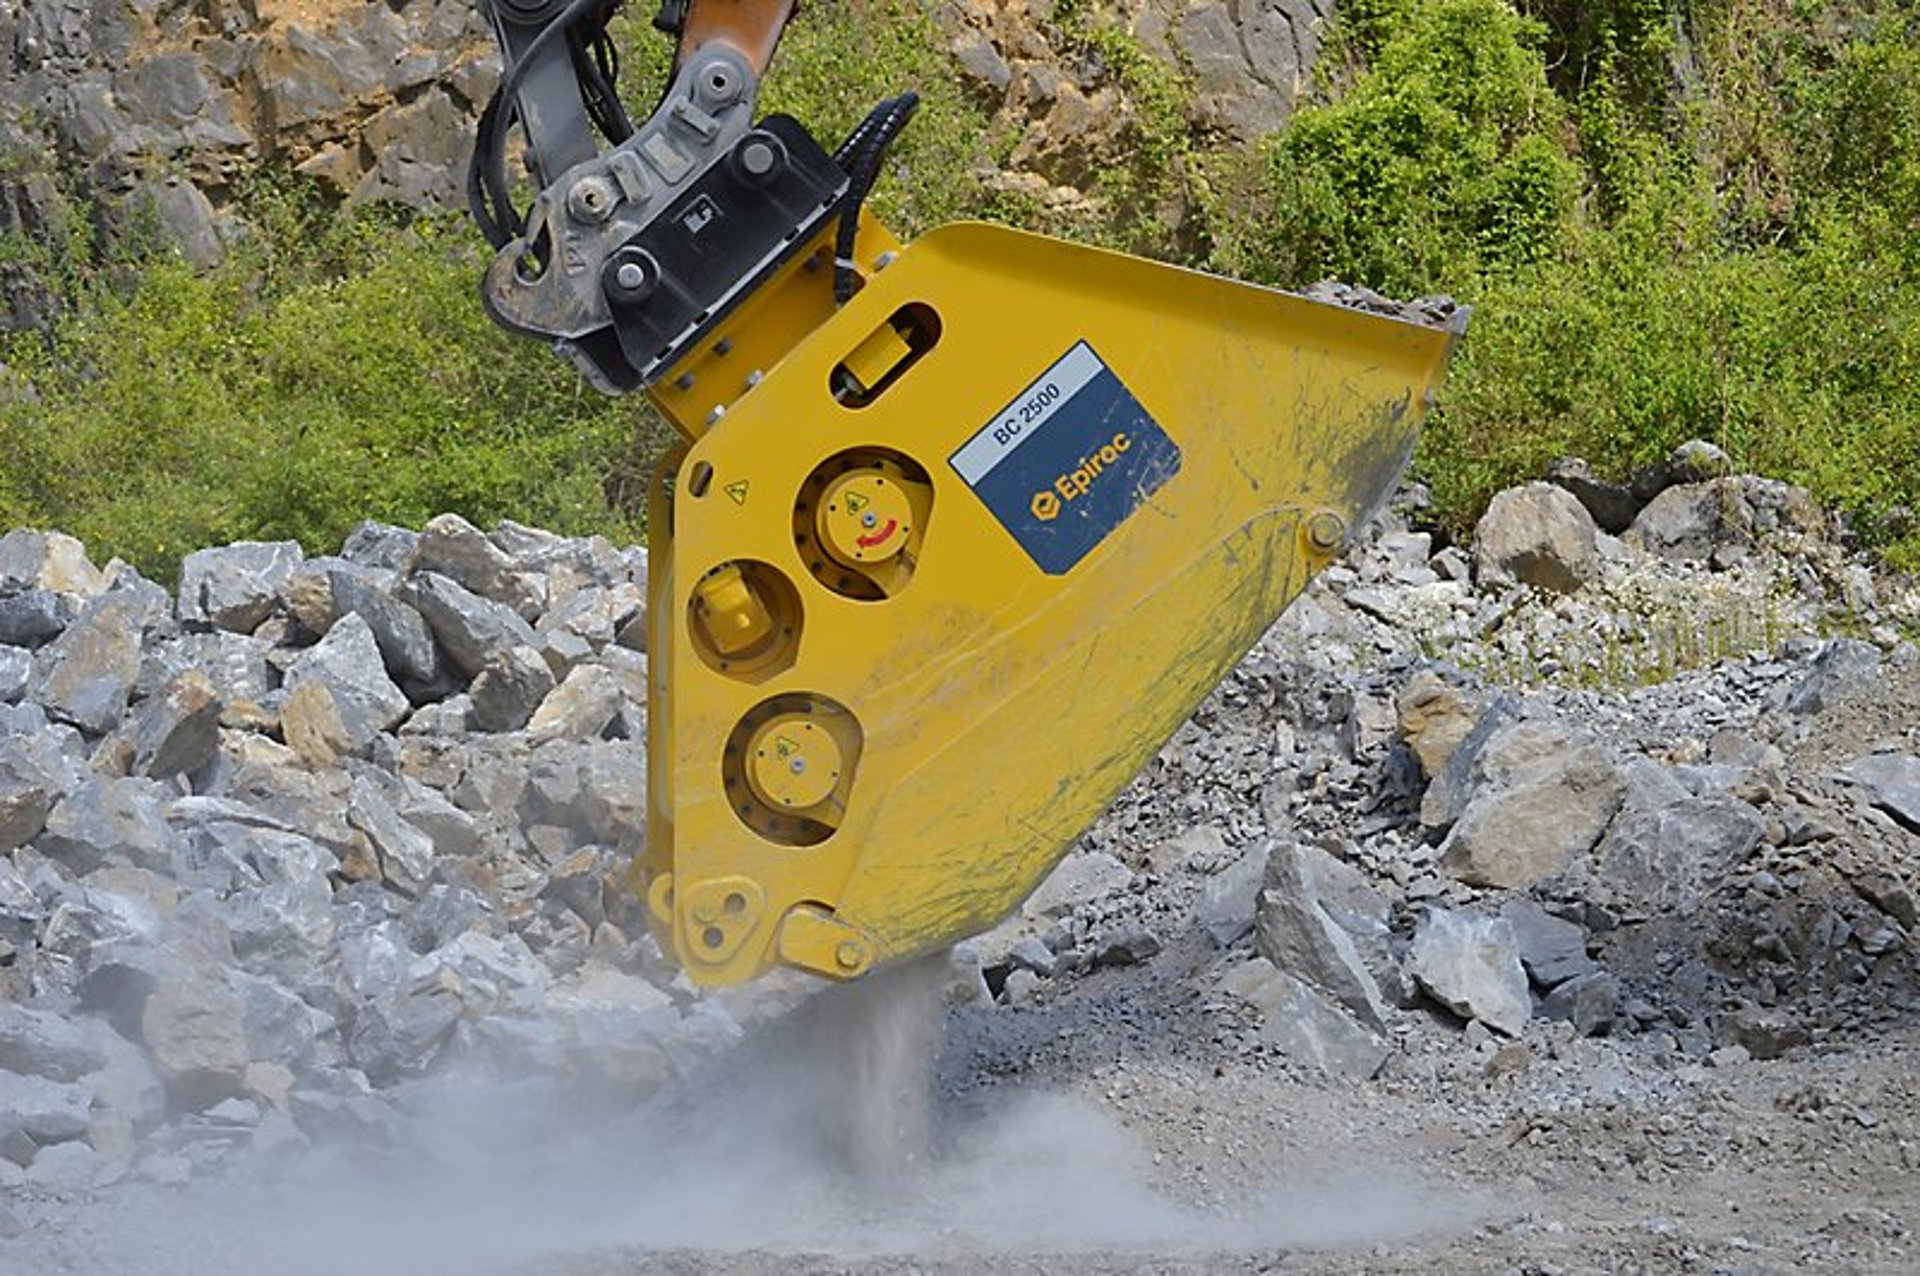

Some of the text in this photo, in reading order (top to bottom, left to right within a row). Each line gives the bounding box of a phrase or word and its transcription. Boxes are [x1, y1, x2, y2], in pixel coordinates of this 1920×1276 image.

[993, 383, 1060, 445] BC 2500
[1056, 433, 1131, 500] Epiroc
